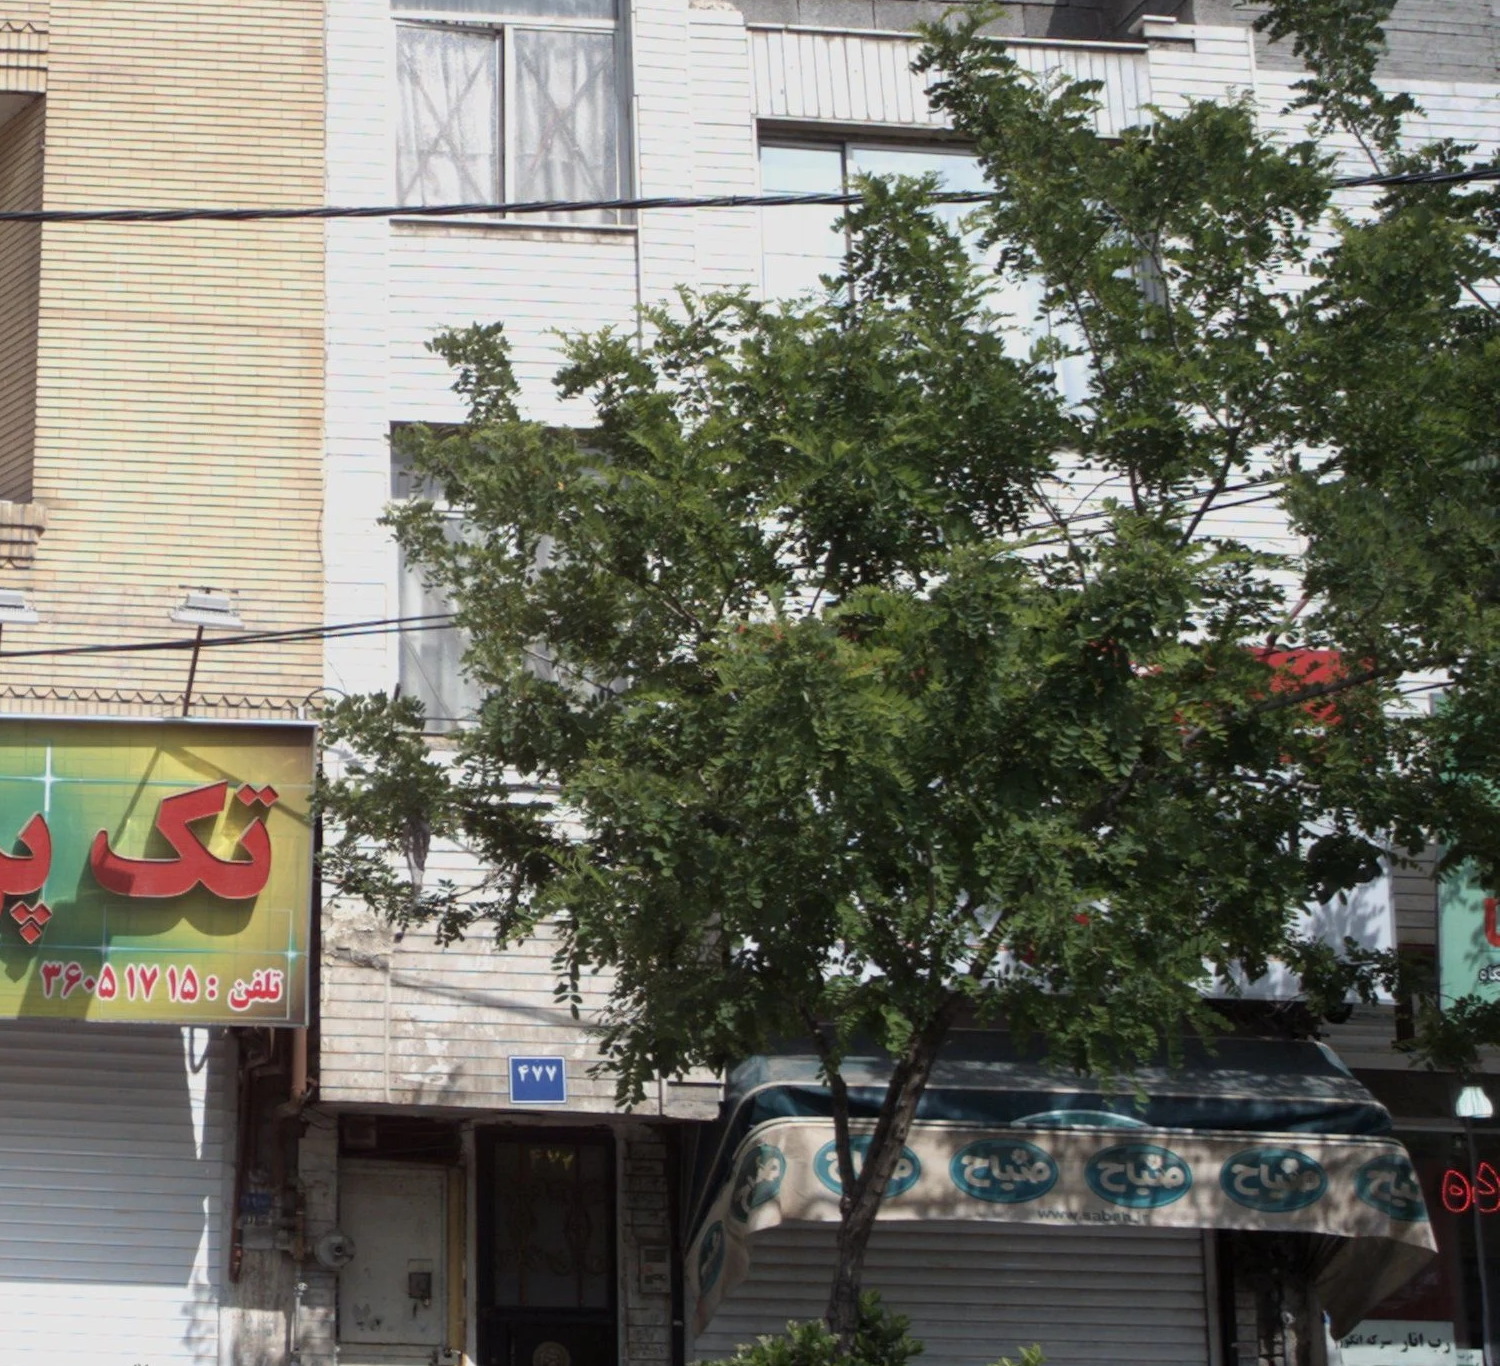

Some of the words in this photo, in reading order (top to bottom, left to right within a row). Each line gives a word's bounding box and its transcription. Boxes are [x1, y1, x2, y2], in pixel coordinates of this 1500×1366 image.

[91, 779, 279, 899] تک
[518, 1064, 557, 1083] ۴۷۷
[1401, 1332, 1424, 1353] انار
[1427, 1336, 1451, 1354] رب
